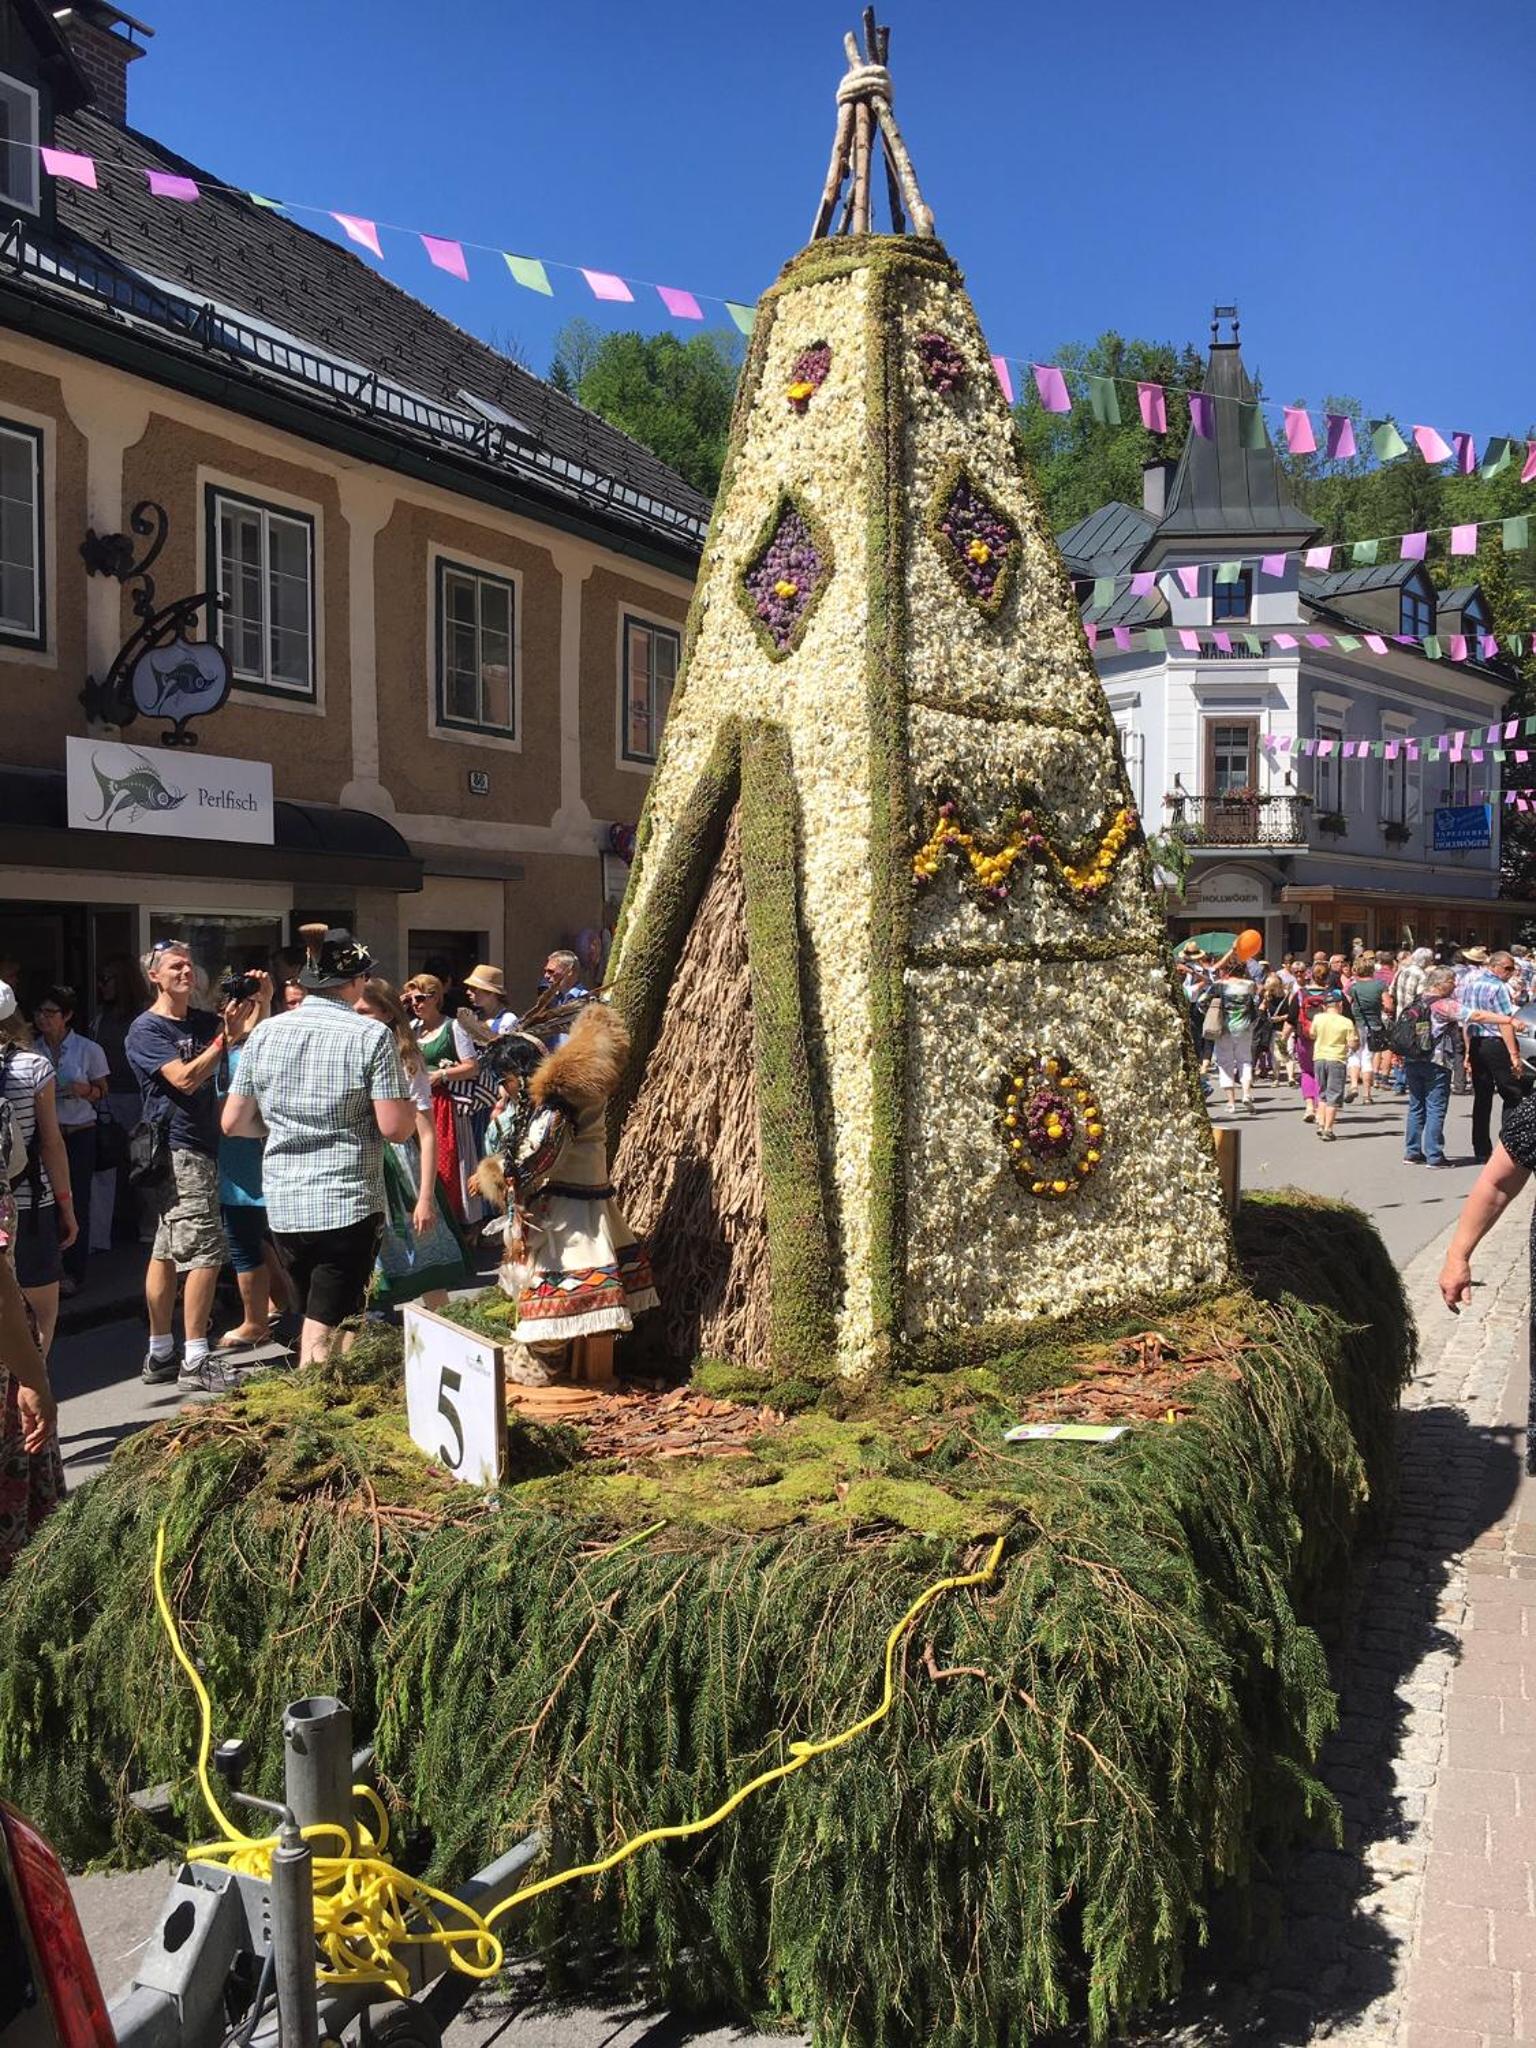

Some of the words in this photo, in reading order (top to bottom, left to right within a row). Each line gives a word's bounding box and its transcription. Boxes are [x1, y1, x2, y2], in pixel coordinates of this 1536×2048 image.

[198, 788, 258, 812] Perlfisch
[1202, 893, 1258, 903] HOLLWÖGER
[438, 1366, 464, 1470] 5
